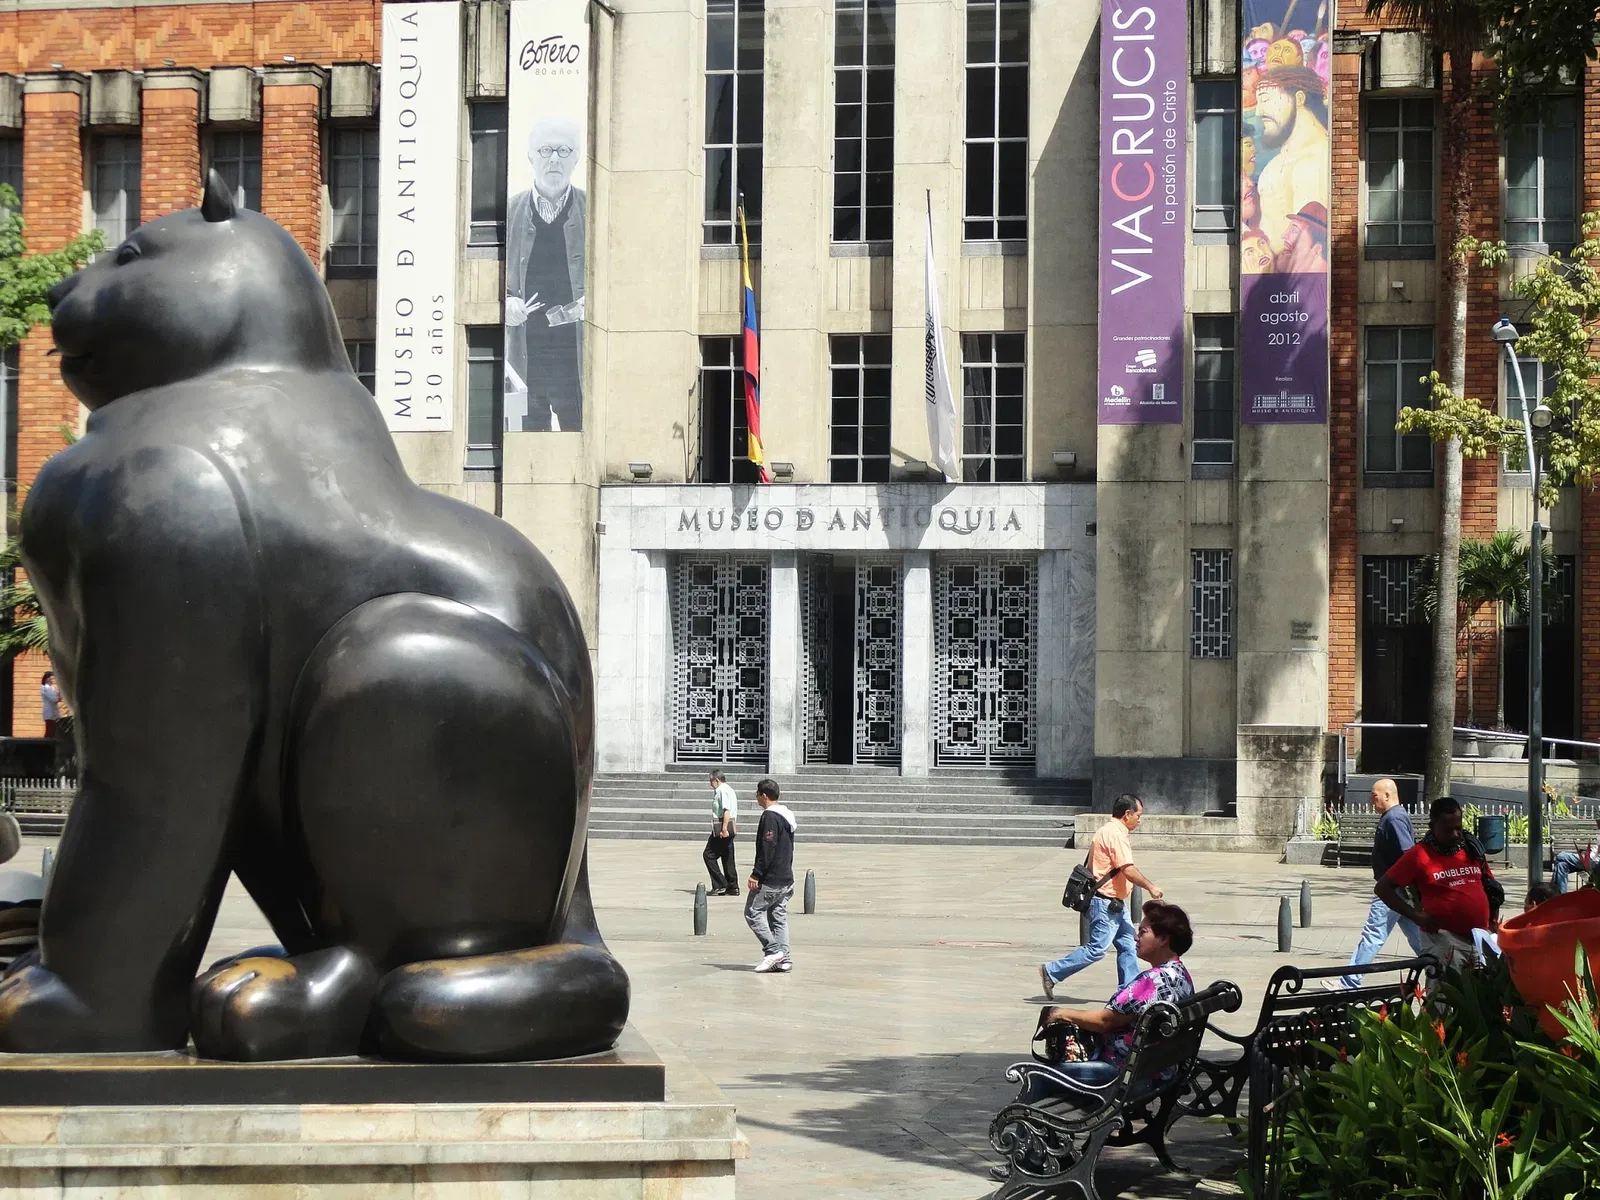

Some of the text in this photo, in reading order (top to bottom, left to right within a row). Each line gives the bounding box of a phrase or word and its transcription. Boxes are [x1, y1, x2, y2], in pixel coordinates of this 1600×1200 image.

[519, 35, 580, 70] Botero
[535, 68, 547, 76] 80
[397, 11, 422, 223] ANTIOQUIA
[1111, 6, 1156, 295] VIACRUCIS
[1161, 80, 1179, 225] la pasión de Cristo
[1269, 291, 1299, 303] abril
[1260, 310, 1309, 325] agosto
[1268, 333, 1300, 345] 2012
[394, 297, 414, 418] MUSEO
[425, 295, 444, 420] 130 años
[677, 507, 784, 532] MUSEO
[827, 507, 1022, 536] ANTIOQUIA
